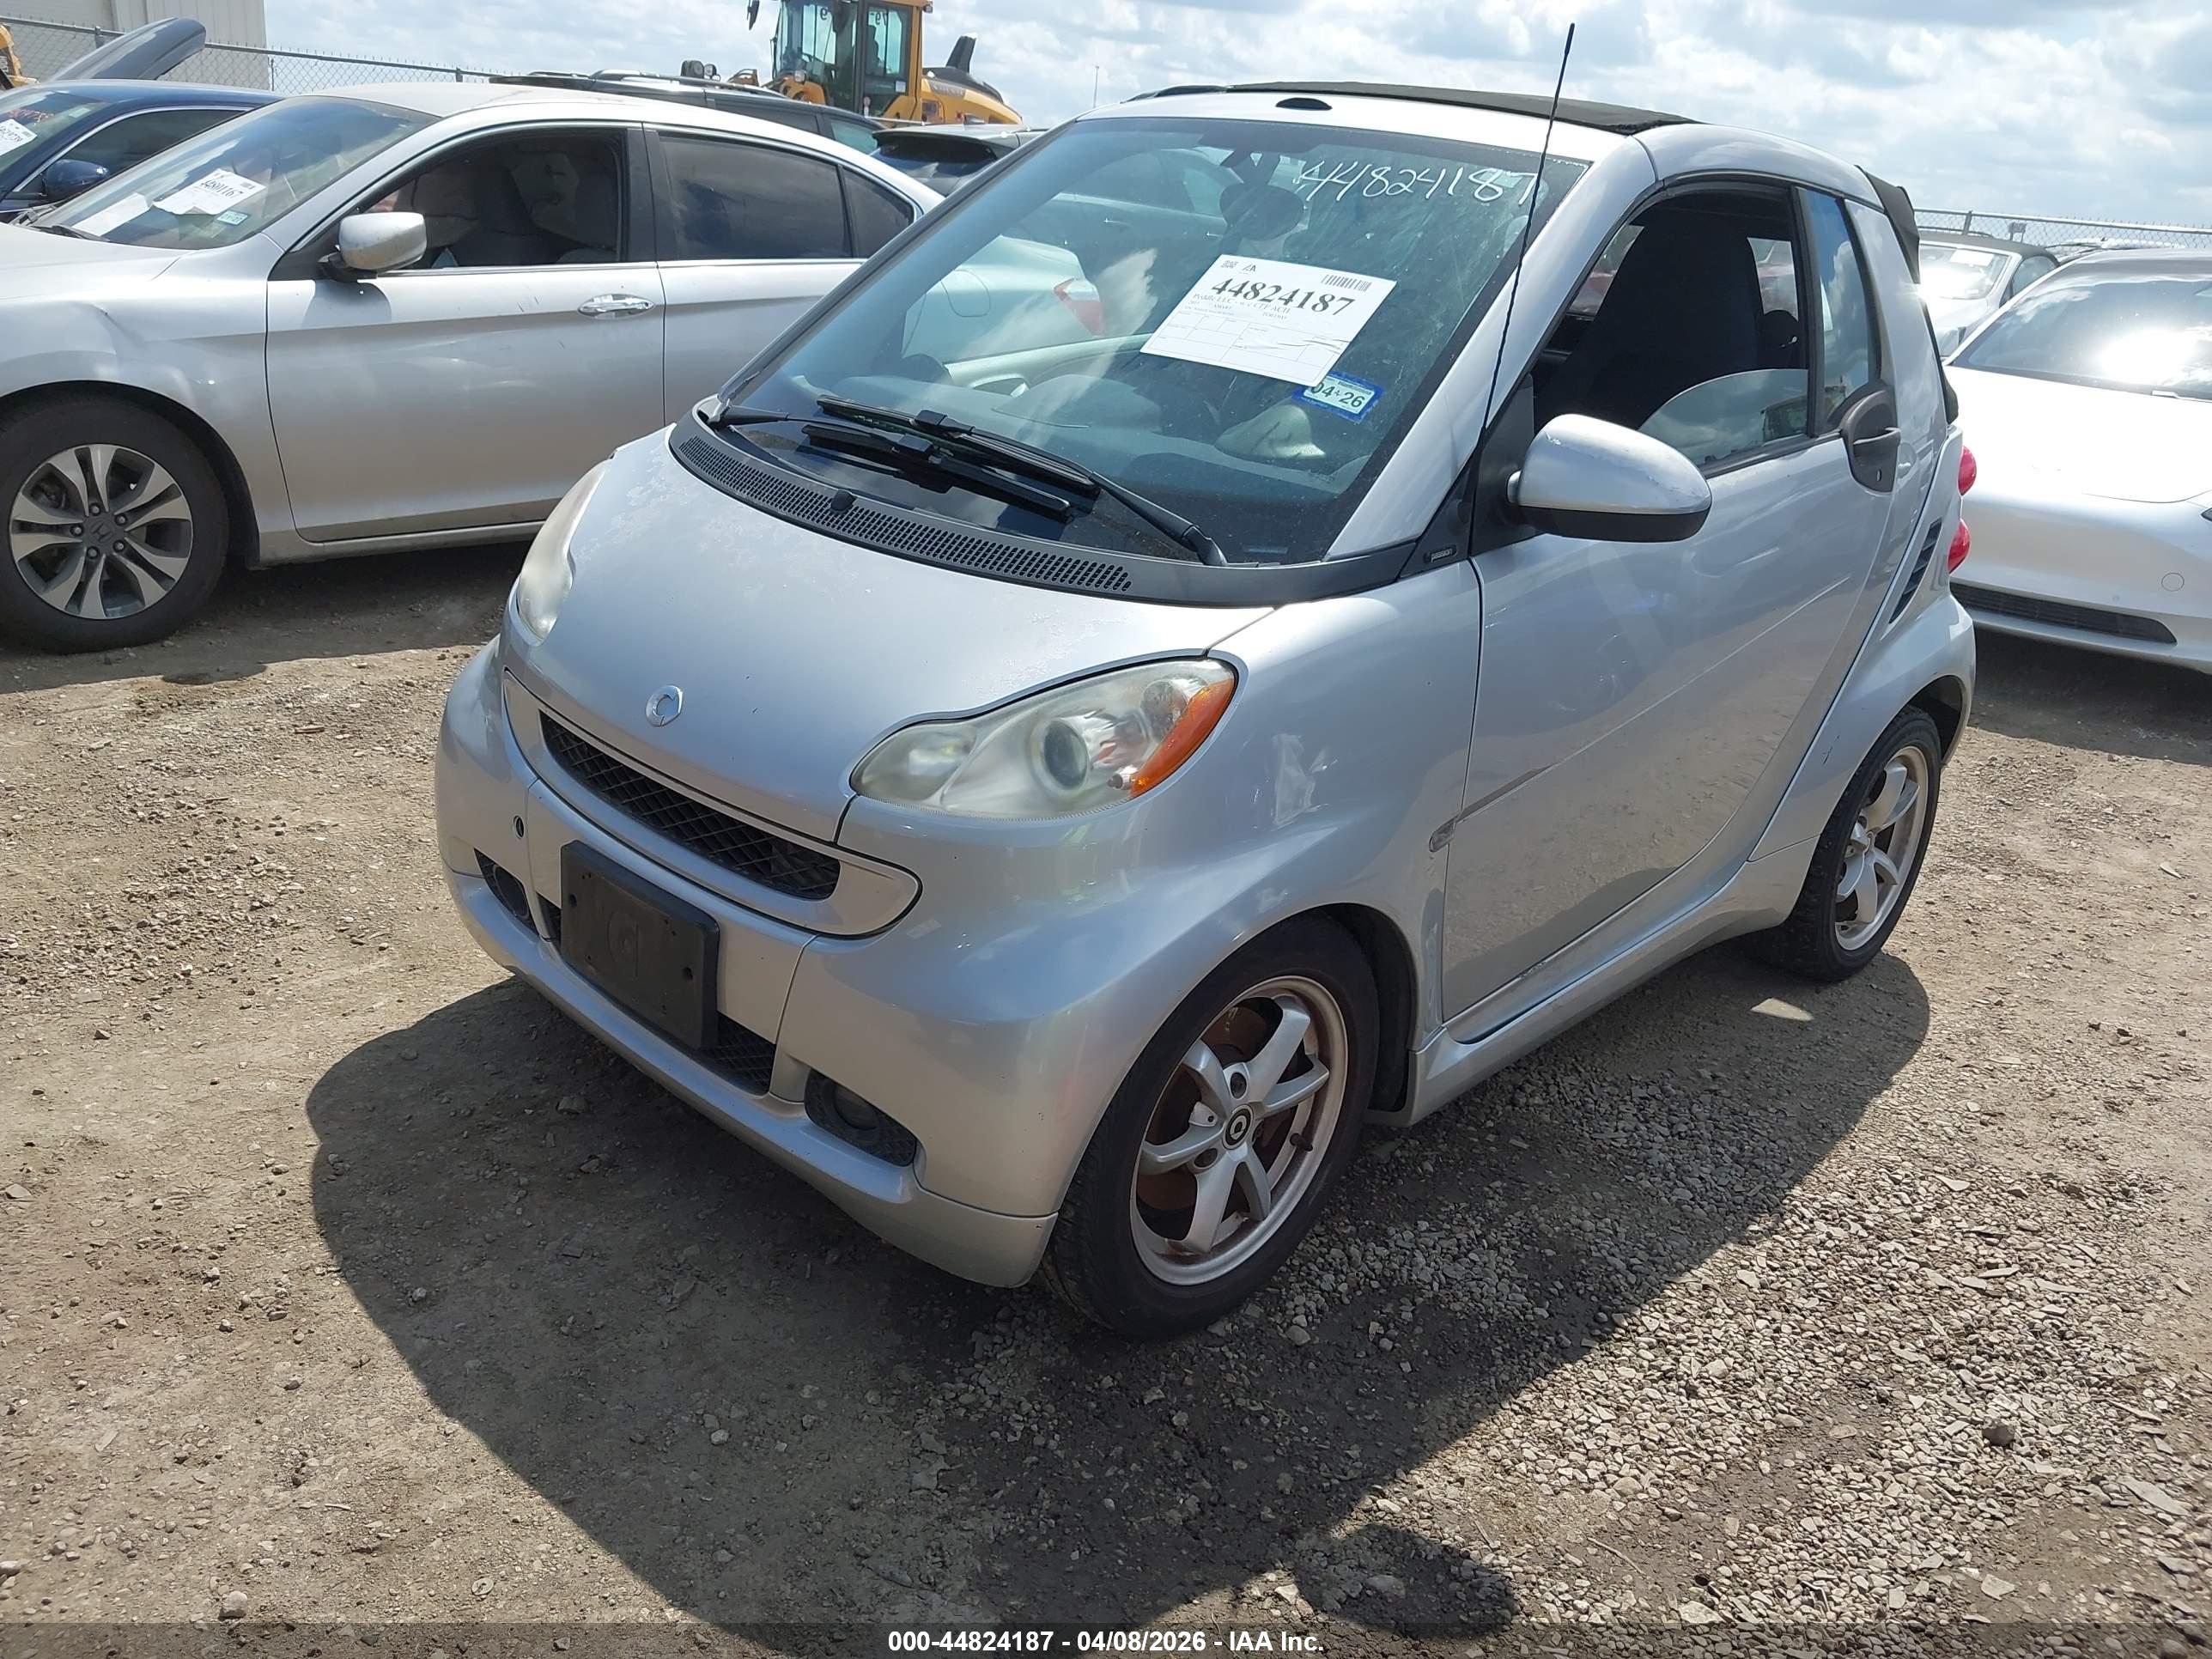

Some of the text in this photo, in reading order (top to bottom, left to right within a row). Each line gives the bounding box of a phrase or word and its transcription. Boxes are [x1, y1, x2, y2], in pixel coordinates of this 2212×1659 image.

[1300, 160, 1538, 206] 44824187
[1212, 277, 1356, 316] 44824187
[1339, 392, 1365, 408] 26
